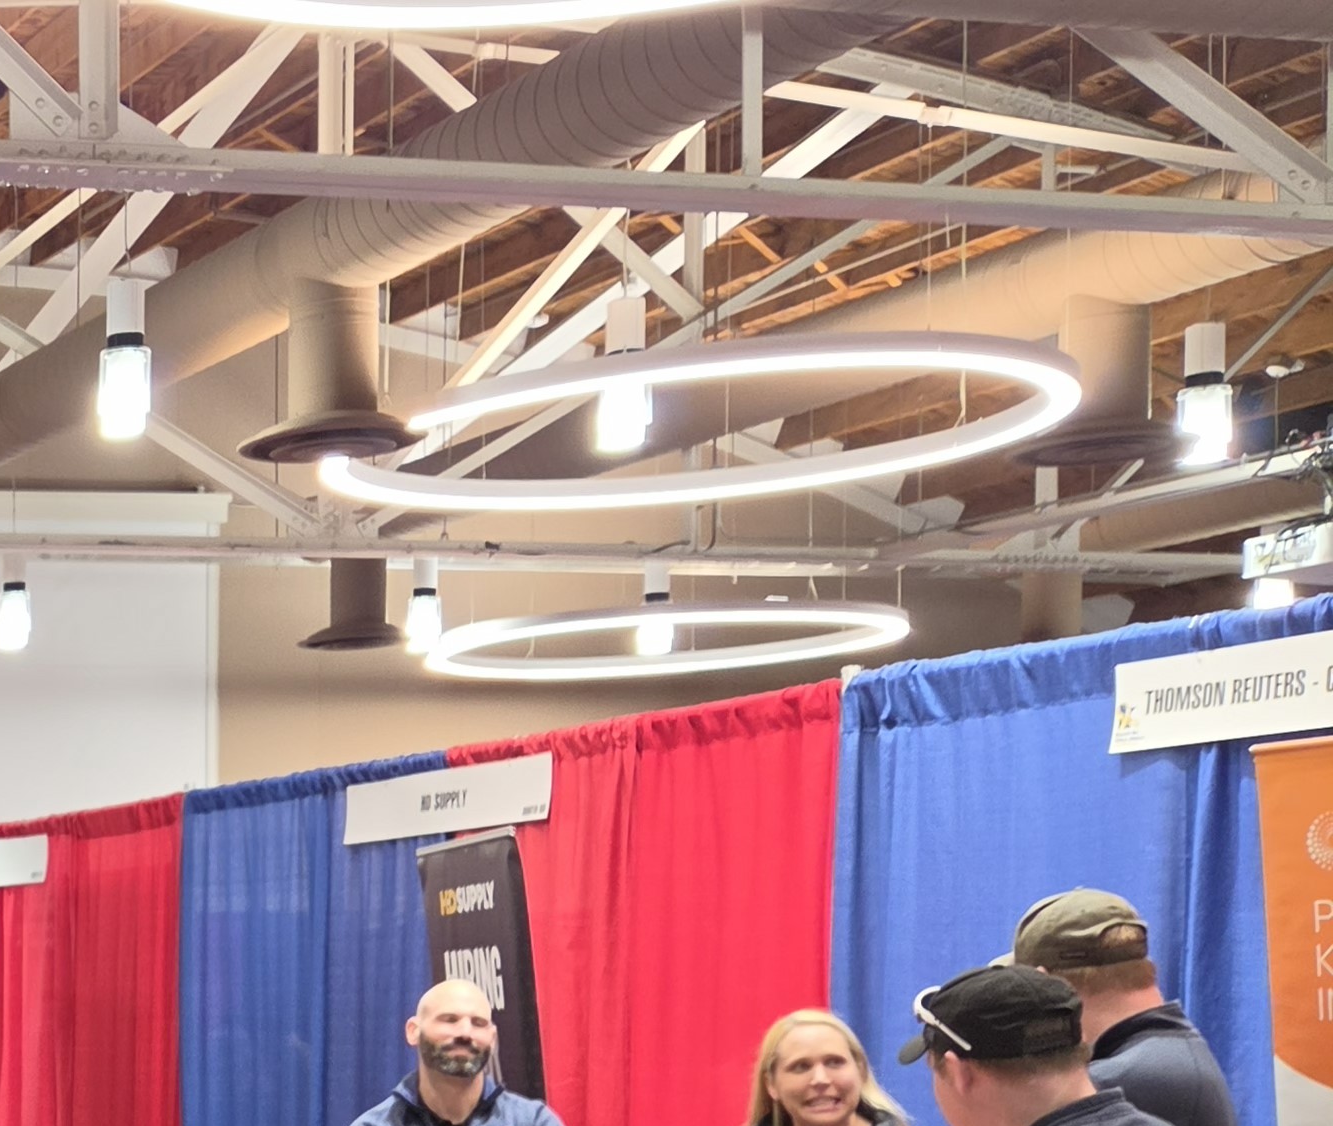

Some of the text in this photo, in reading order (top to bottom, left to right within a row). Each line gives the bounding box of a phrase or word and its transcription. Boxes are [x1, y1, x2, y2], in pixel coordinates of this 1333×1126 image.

[1144, 680, 1227, 716] THOMSON
[1230, 668, 1307, 705] REUTERS
[420, 789, 468, 812] HD SUPPLY
